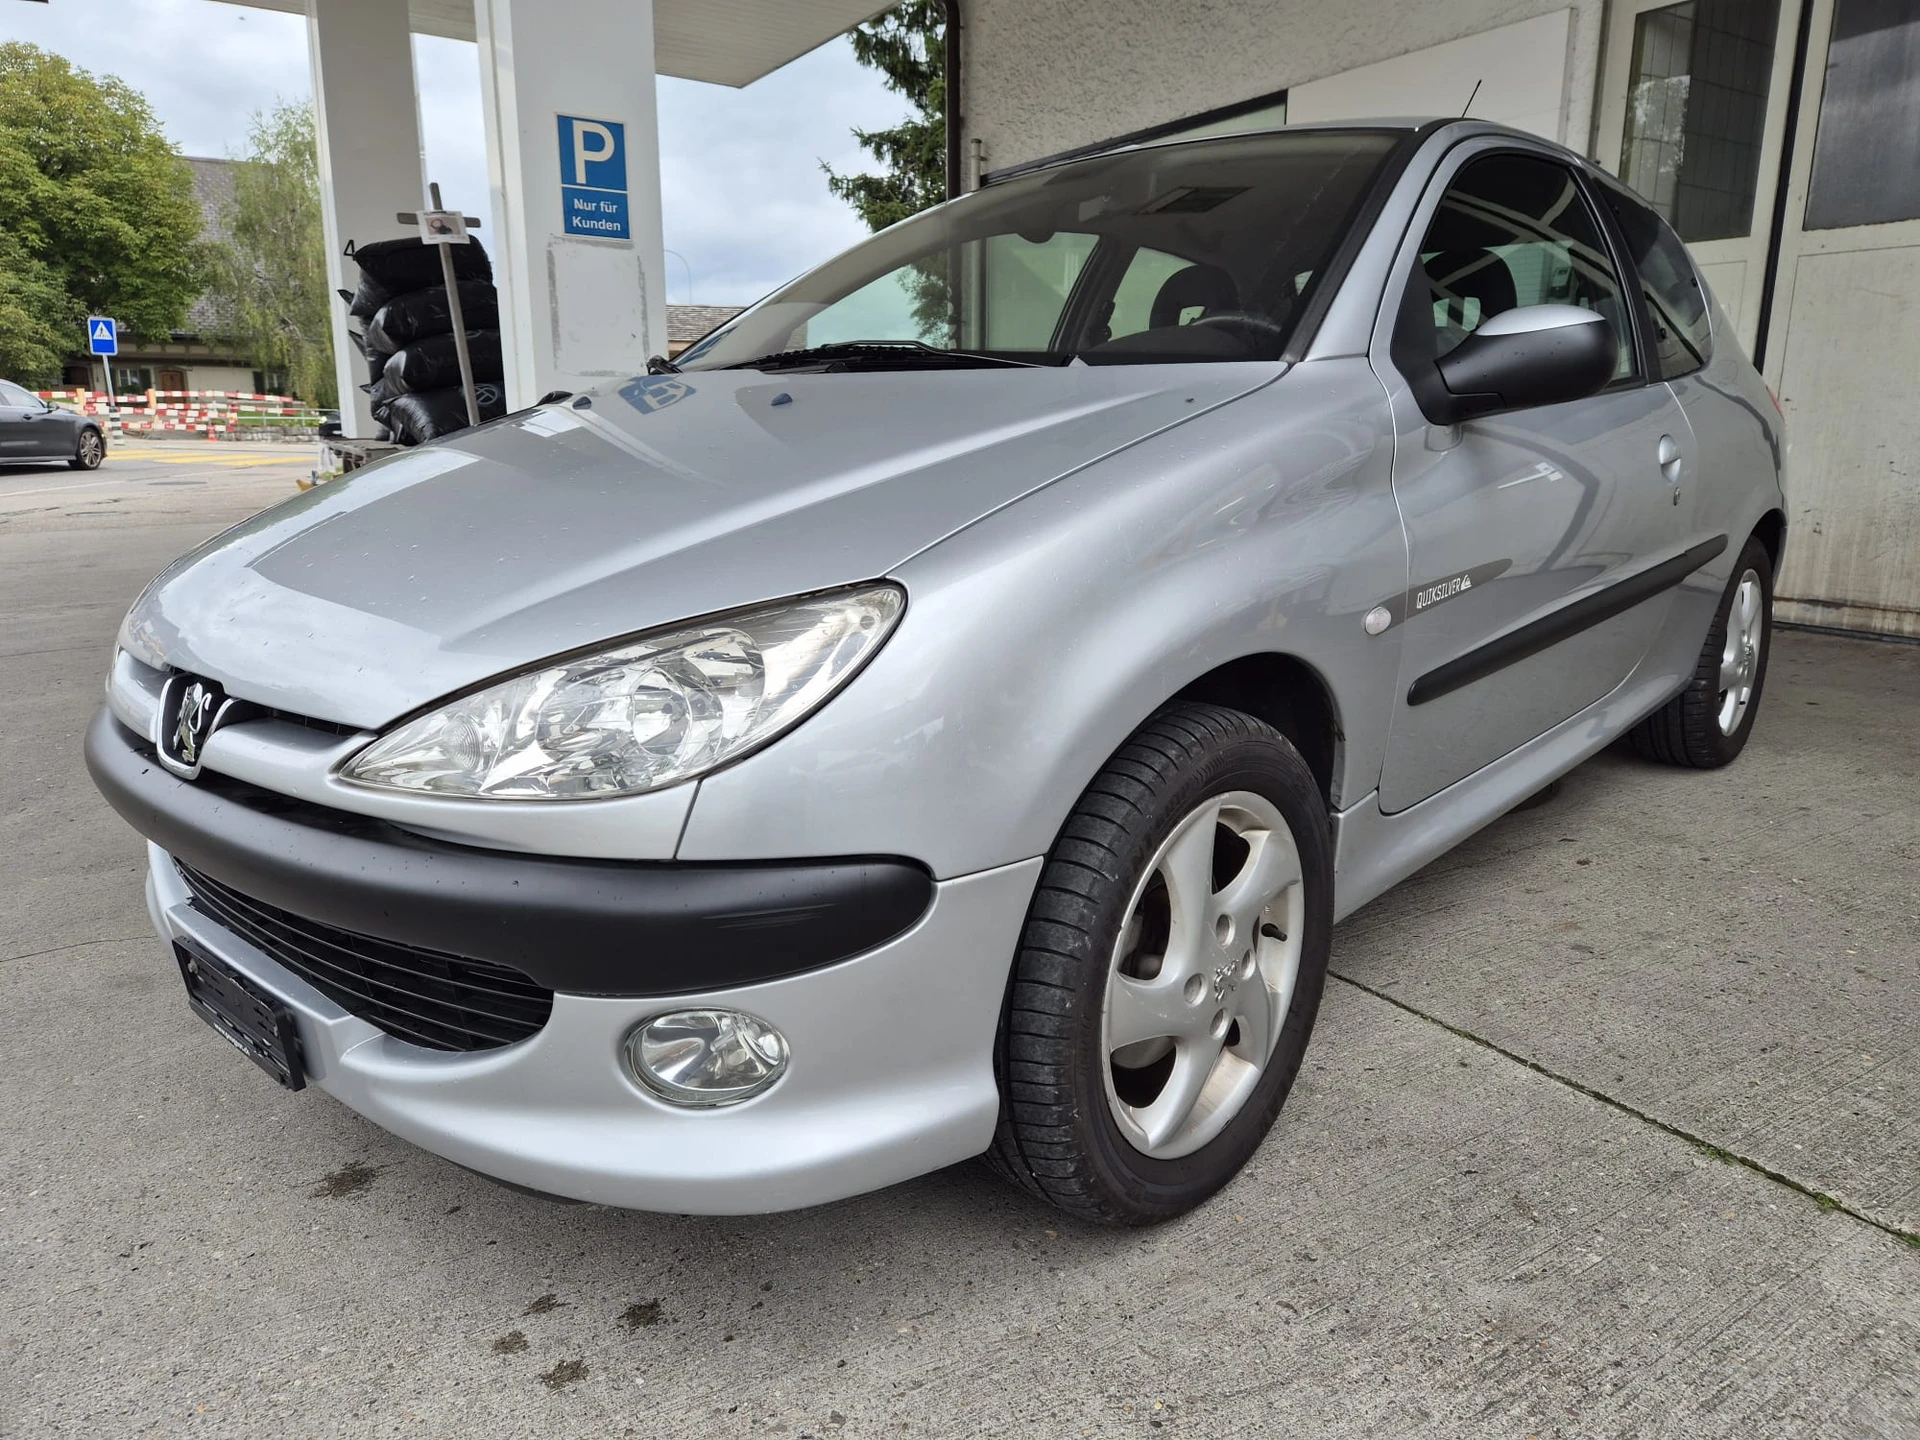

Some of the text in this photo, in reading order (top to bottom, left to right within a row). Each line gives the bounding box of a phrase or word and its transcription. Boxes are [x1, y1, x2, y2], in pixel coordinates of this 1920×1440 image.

[572, 119, 615, 184] P
[573, 198, 618, 214] Nur für
[572, 216, 621, 231] Kunden
[1416, 577, 1461, 609] QUIKSILVER
